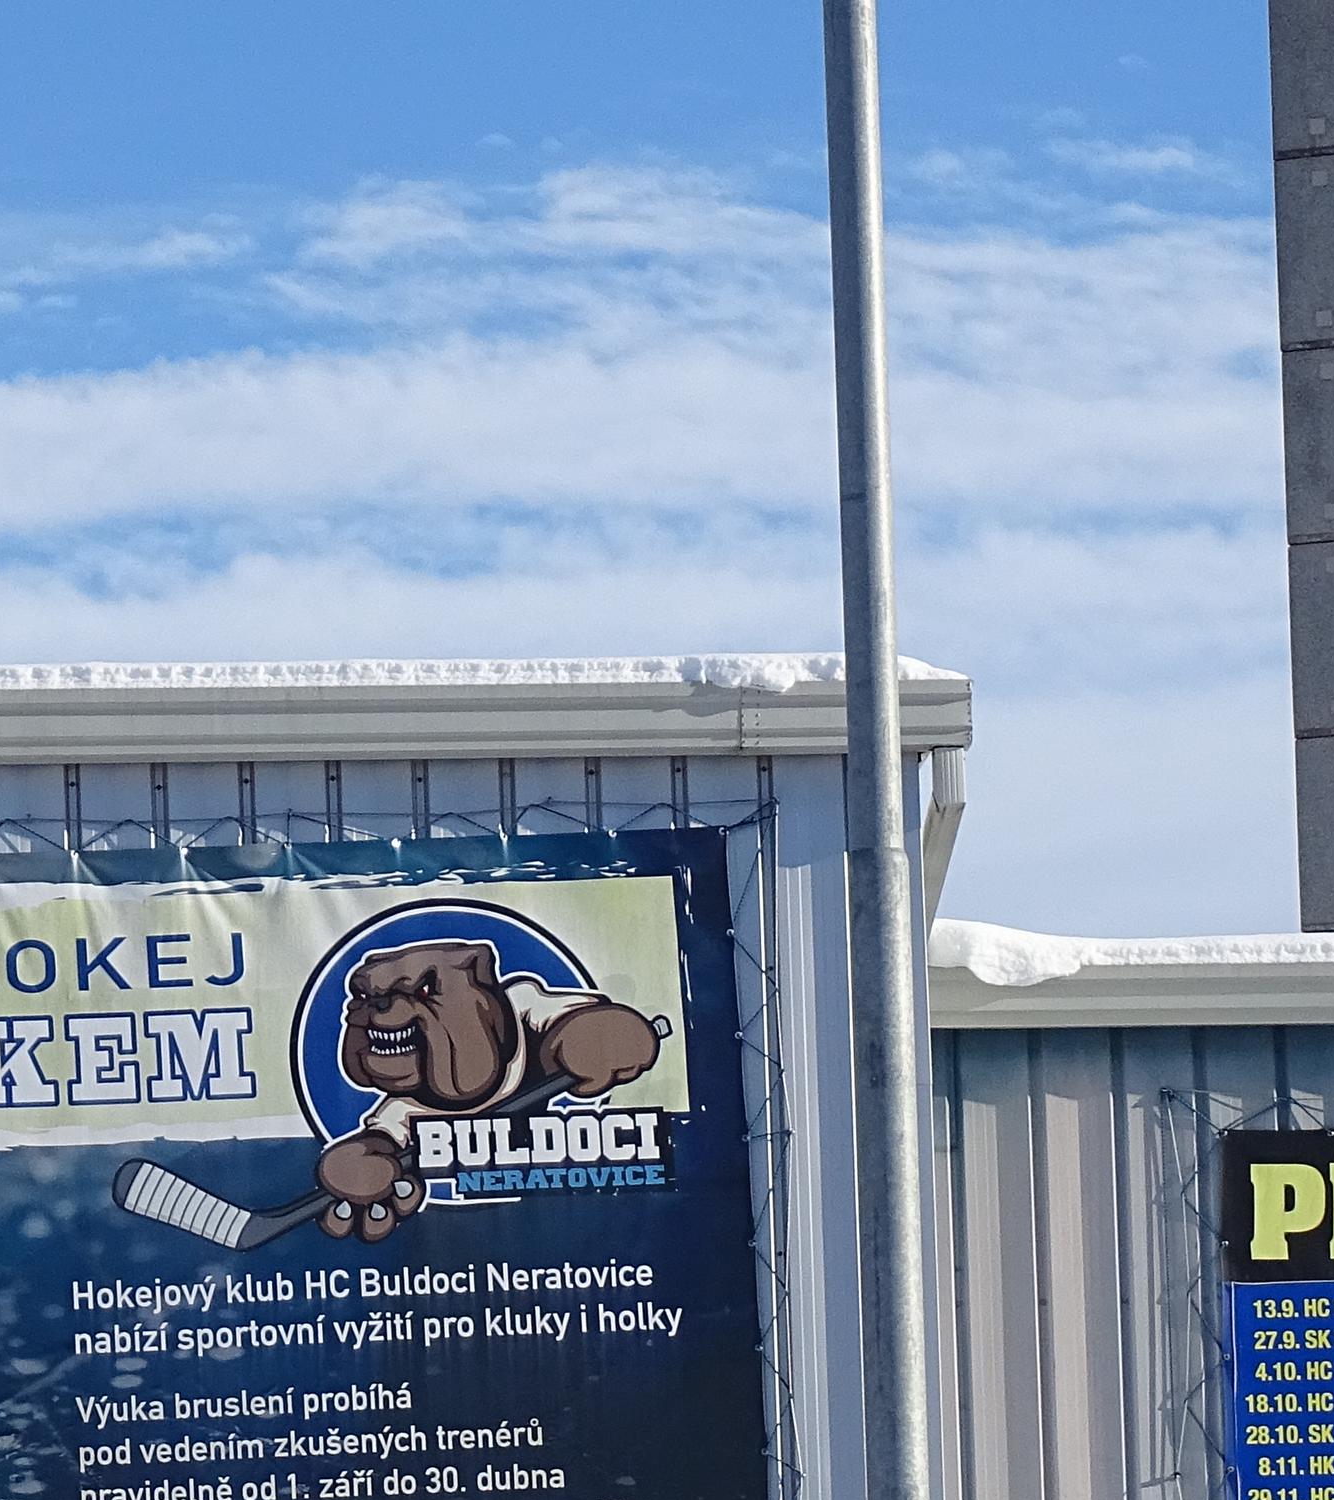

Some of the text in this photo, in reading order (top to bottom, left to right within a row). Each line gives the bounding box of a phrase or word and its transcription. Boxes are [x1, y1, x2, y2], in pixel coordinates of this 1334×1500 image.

[416, 1112, 661, 1168] BULDOCI
[457, 1164, 665, 1192] NERATOVICE
[72, 1262, 653, 1315] Hokejový klub HC Buldoci Neratovice
[1252, 1299, 1299, 1319] 13.9.
[1303, 1298, 1331, 1318] HC
[74, 1301, 683, 1357] nabízí sportovní vyžití pro kluky i holky
[1253, 1330, 1301, 1350] 27.9.
[1304, 1329, 1332, 1349] SK
[1255, 1361, 1302, 1382] 4.10.
[1306, 1360, 1333, 1381] HC
[75, 1382, 412, 1425] Výuka bruslení probíhá
[1245, 1393, 1303, 1413] 18.10.
[1307, 1392, 1334, 1412] HC
[79, 1418, 543, 1474] pod vedením zkušených trenérů
[1245, 1424, 1304, 1445] 28.10.
[1308, 1424, 1334, 1444] SK
[1258, 1456, 1305, 1476] 8.11.
[287, 1473, 310, 1500] 1.
[319, 1469, 374, 1498] září
[383, 1468, 417, 1496] do
[425, 1466, 466, 1494] 30.
[477, 1463, 565, 1492] dubna
